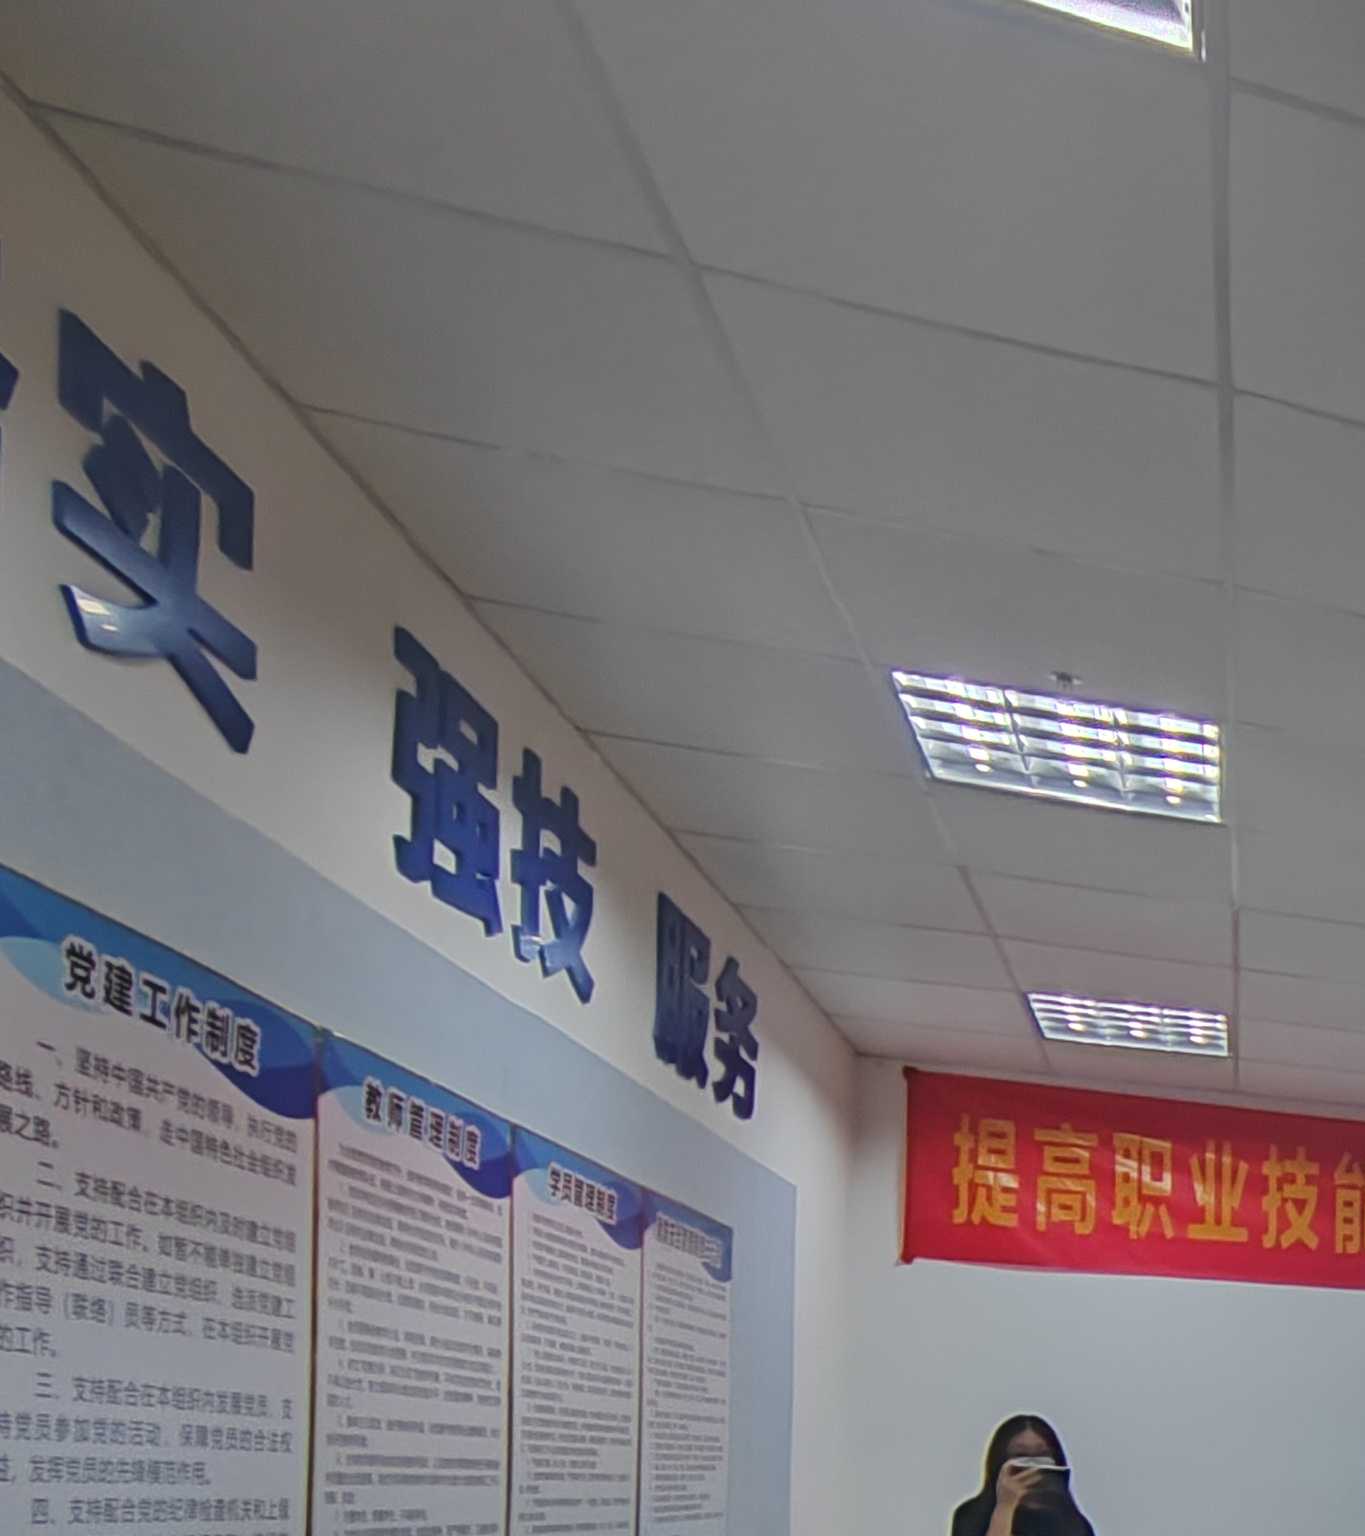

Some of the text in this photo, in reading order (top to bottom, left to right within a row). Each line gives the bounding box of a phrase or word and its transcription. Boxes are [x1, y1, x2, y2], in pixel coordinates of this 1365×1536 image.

[0, 306, 760, 1121] 实 强技 服务
[63, 940, 260, 1075] 党建工作制度
[363, 1079, 481, 1169] 教师管理制度
